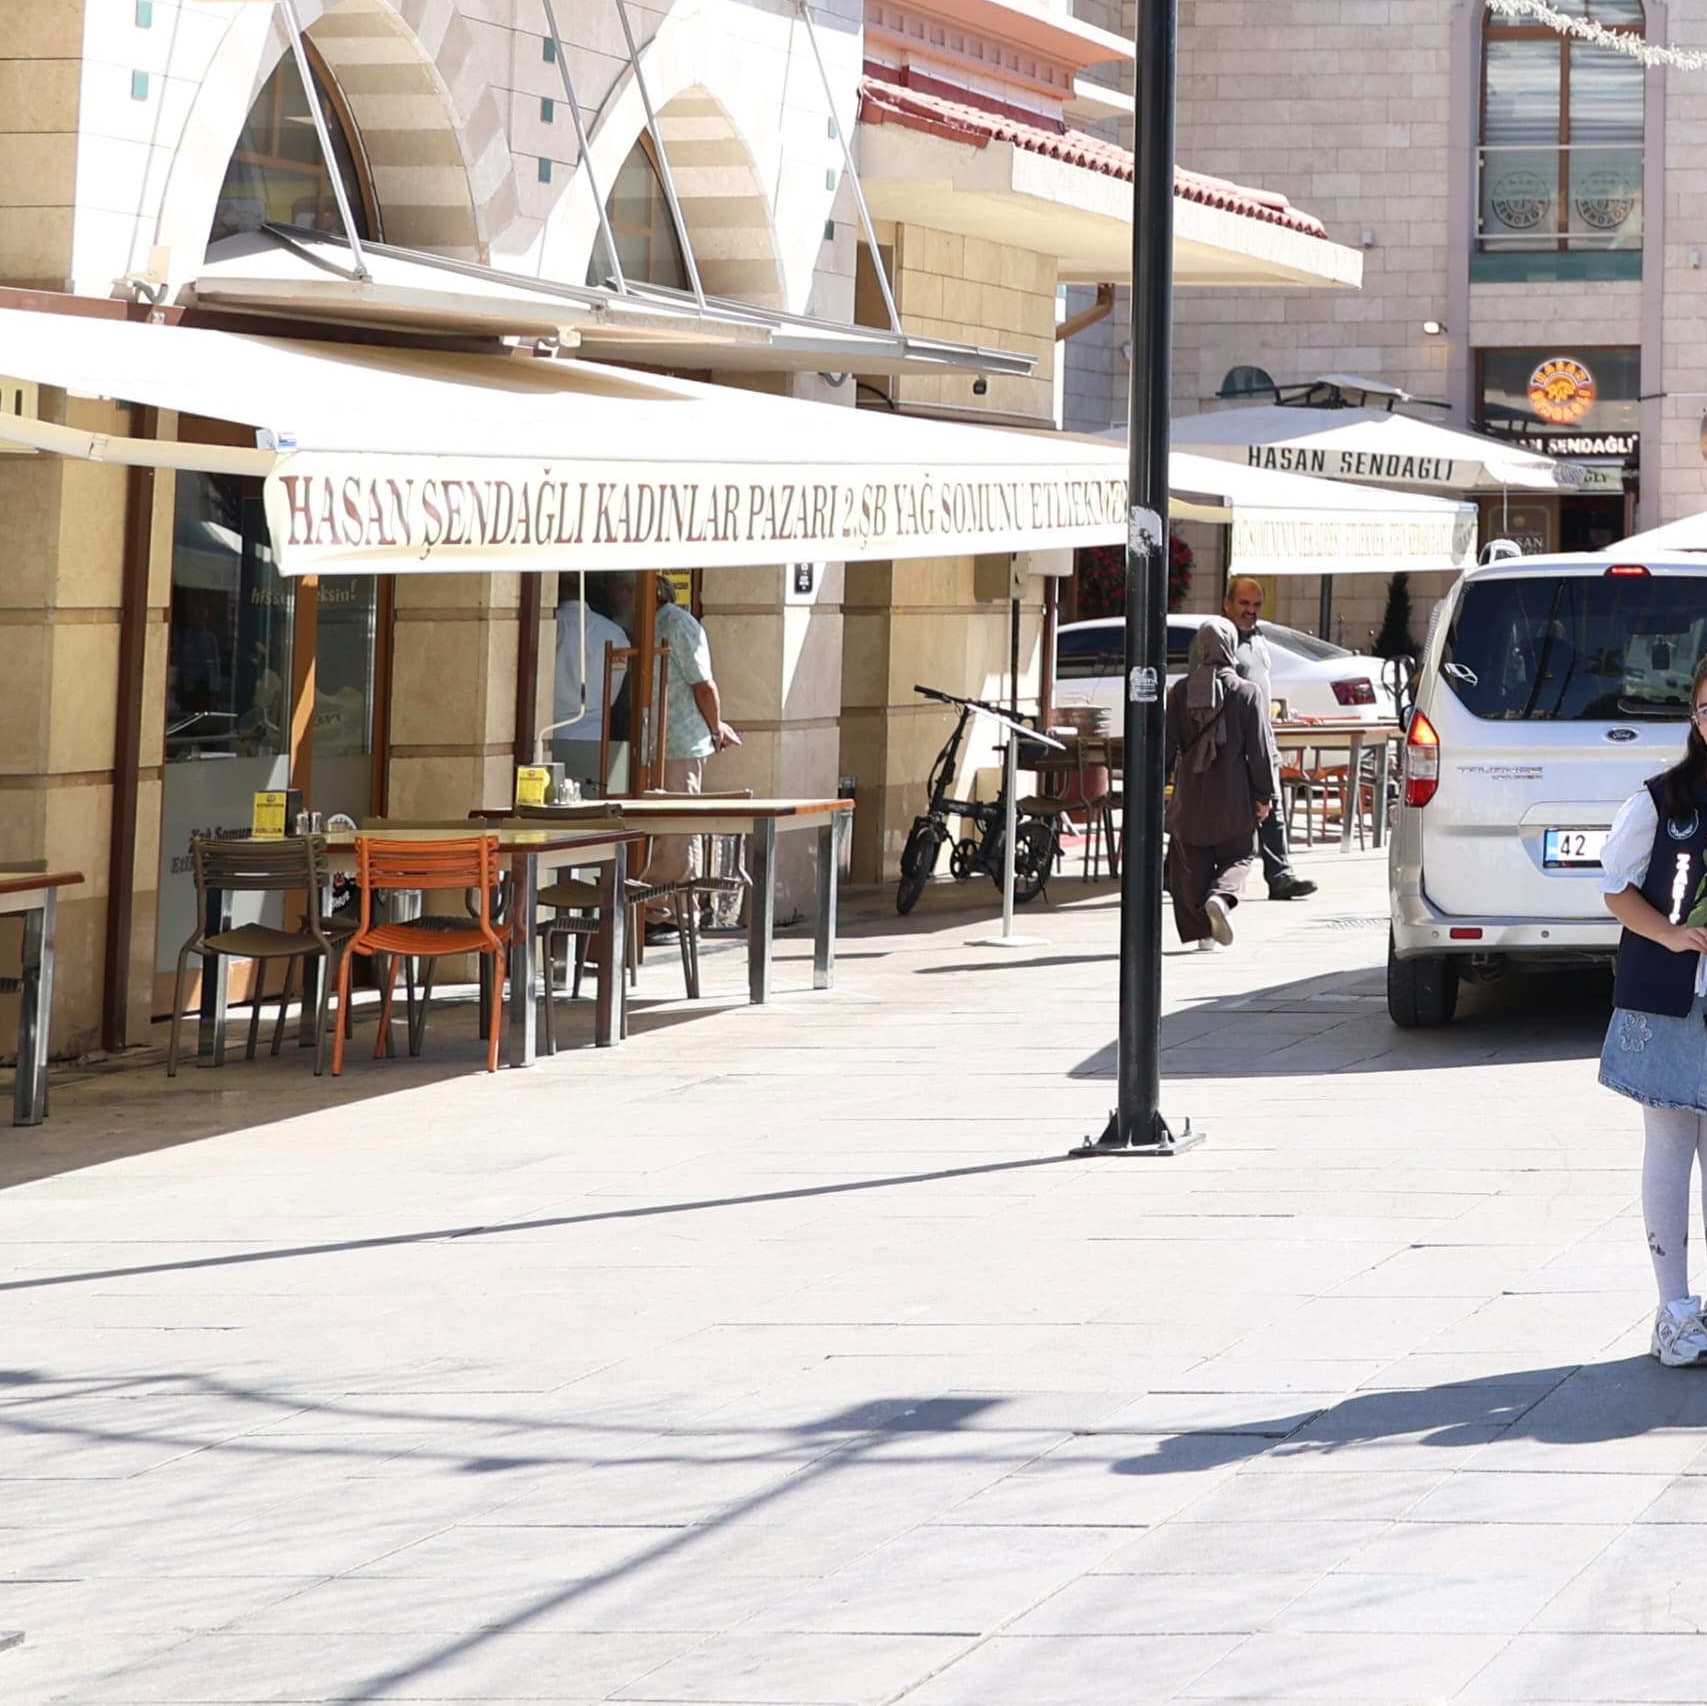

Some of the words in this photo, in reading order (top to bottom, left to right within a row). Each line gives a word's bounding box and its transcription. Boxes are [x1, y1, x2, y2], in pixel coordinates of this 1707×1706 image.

[1248, 444, 1326, 473] HASAN
[279, 475, 414, 547] HASAN
[419, 466, 588, 560] ŞENDAĞLI
[592, 482, 739, 544] KADINLAR
[746, 482, 838, 541] PAZARI
[894, 472, 936, 537] YAĞ
[940, 480, 1026, 535] SOMUNU
[1559, 834, 1587, 857] 42
